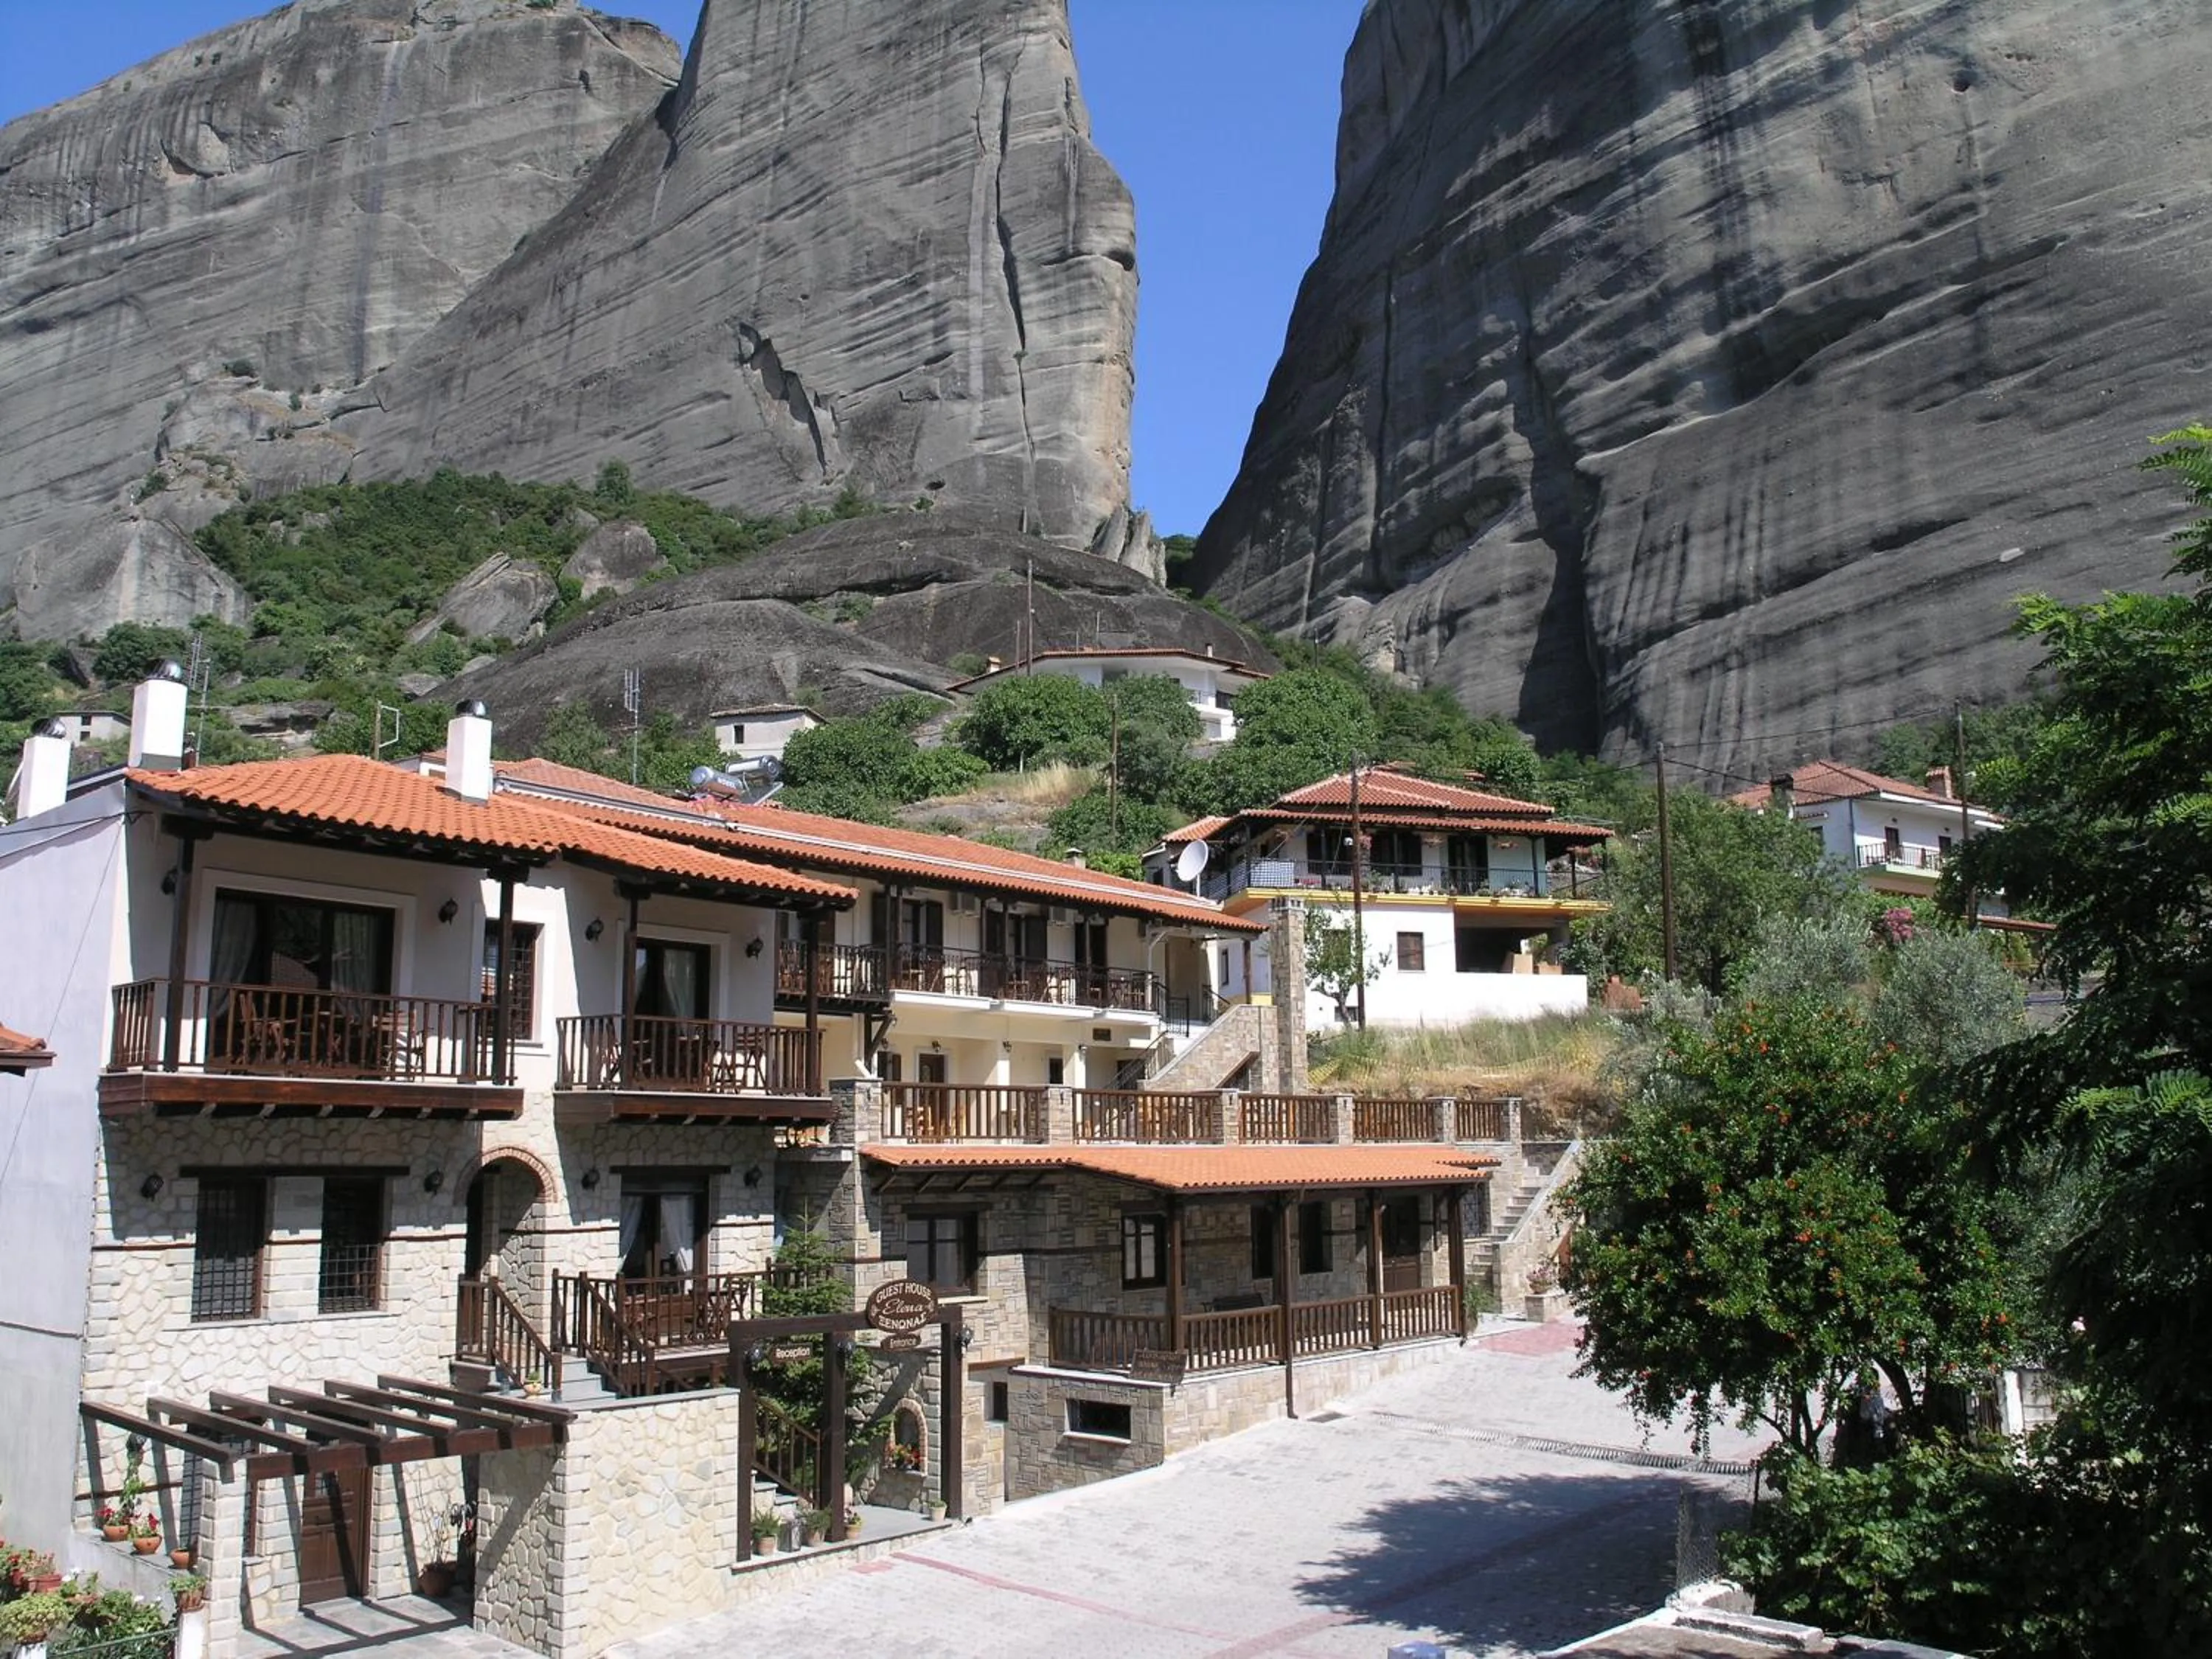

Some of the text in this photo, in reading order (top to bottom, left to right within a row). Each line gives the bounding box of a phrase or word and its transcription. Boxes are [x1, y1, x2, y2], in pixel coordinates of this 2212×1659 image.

[876, 1282, 932, 1303] GUEST HOUSE
[882, 1298, 923, 1315] Elena
[776, 1347, 811, 1360] Reception
